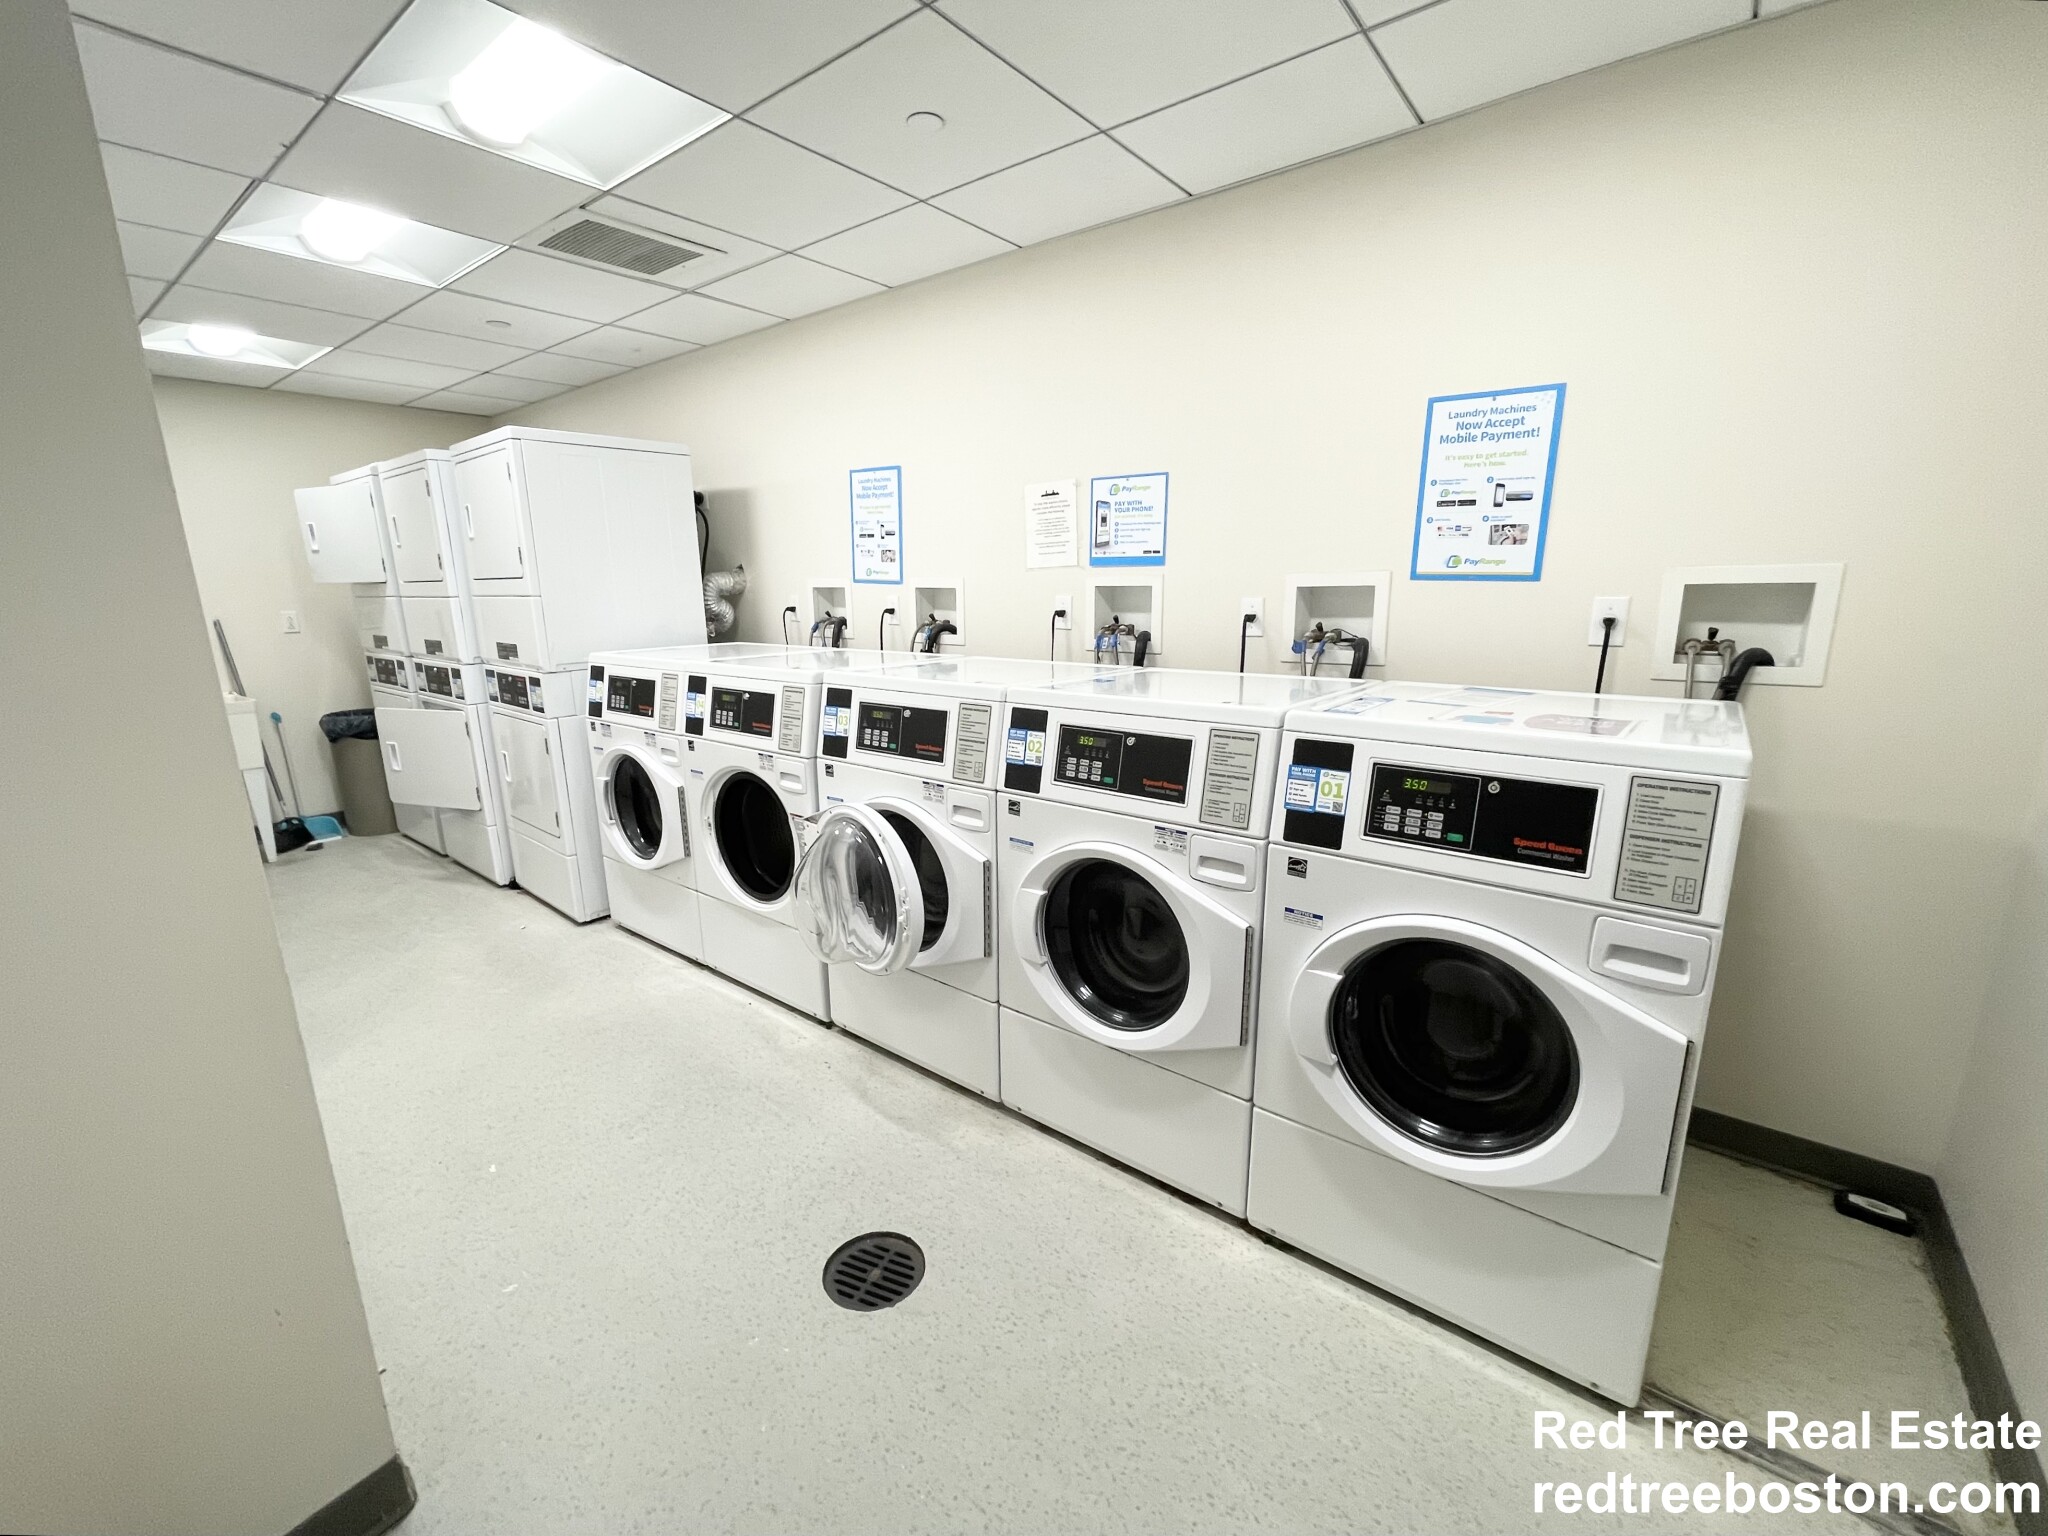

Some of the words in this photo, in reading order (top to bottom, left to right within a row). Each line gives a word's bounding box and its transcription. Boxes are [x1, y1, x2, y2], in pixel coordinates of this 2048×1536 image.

[1448, 409, 1487, 419] Laundry
[1490, 404, 1537, 415] Machines
[1456, 421, 1482, 431] Now
[1484, 416, 1526, 429] Accept
[1440, 432, 1478, 444] Mobile
[1480, 427, 1541, 443] Payment!
[1028, 740, 1042, 753] 02
[1321, 781, 1343, 799] 01
[1514, 837, 1546, 849] Speed
[1548, 842, 1582, 854] Queen
[1517, 847, 1551, 858] Commercial
[1552, 853, 1574, 861] Washer
